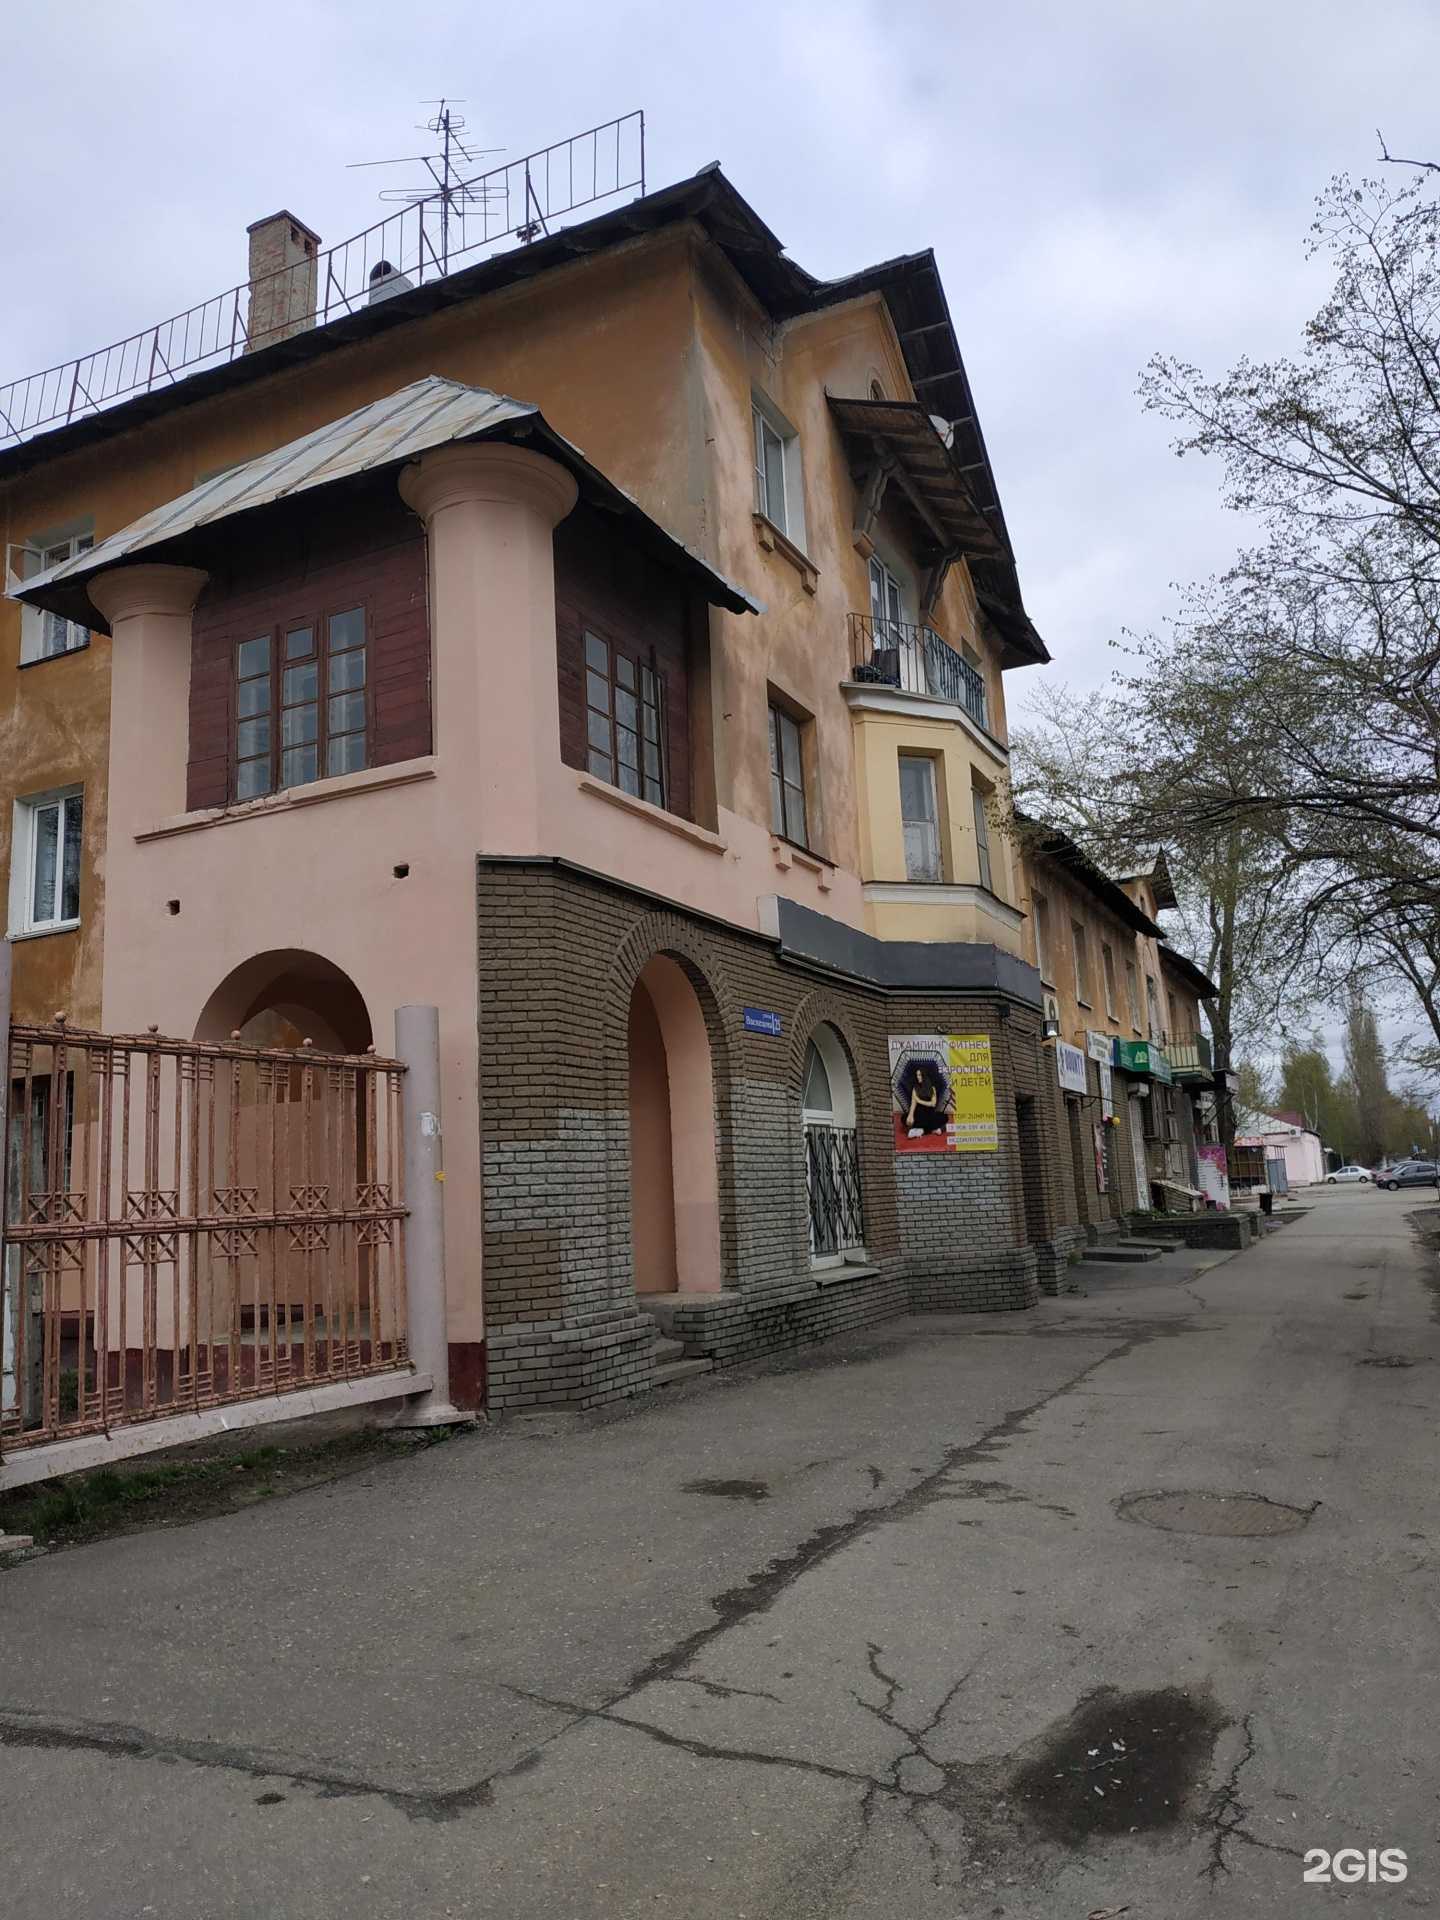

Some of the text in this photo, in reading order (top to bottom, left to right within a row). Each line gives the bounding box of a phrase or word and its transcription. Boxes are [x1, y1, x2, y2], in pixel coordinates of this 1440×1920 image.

[891, 1040, 947, 1050] ДЖАМПИНГ
[969, 1053, 989, 1062] ДЛЯ
[938, 1064, 991, 1074] ВЗРОСЛЫХ
[951, 1076, 991, 1088] И ДЕТЕЙ
